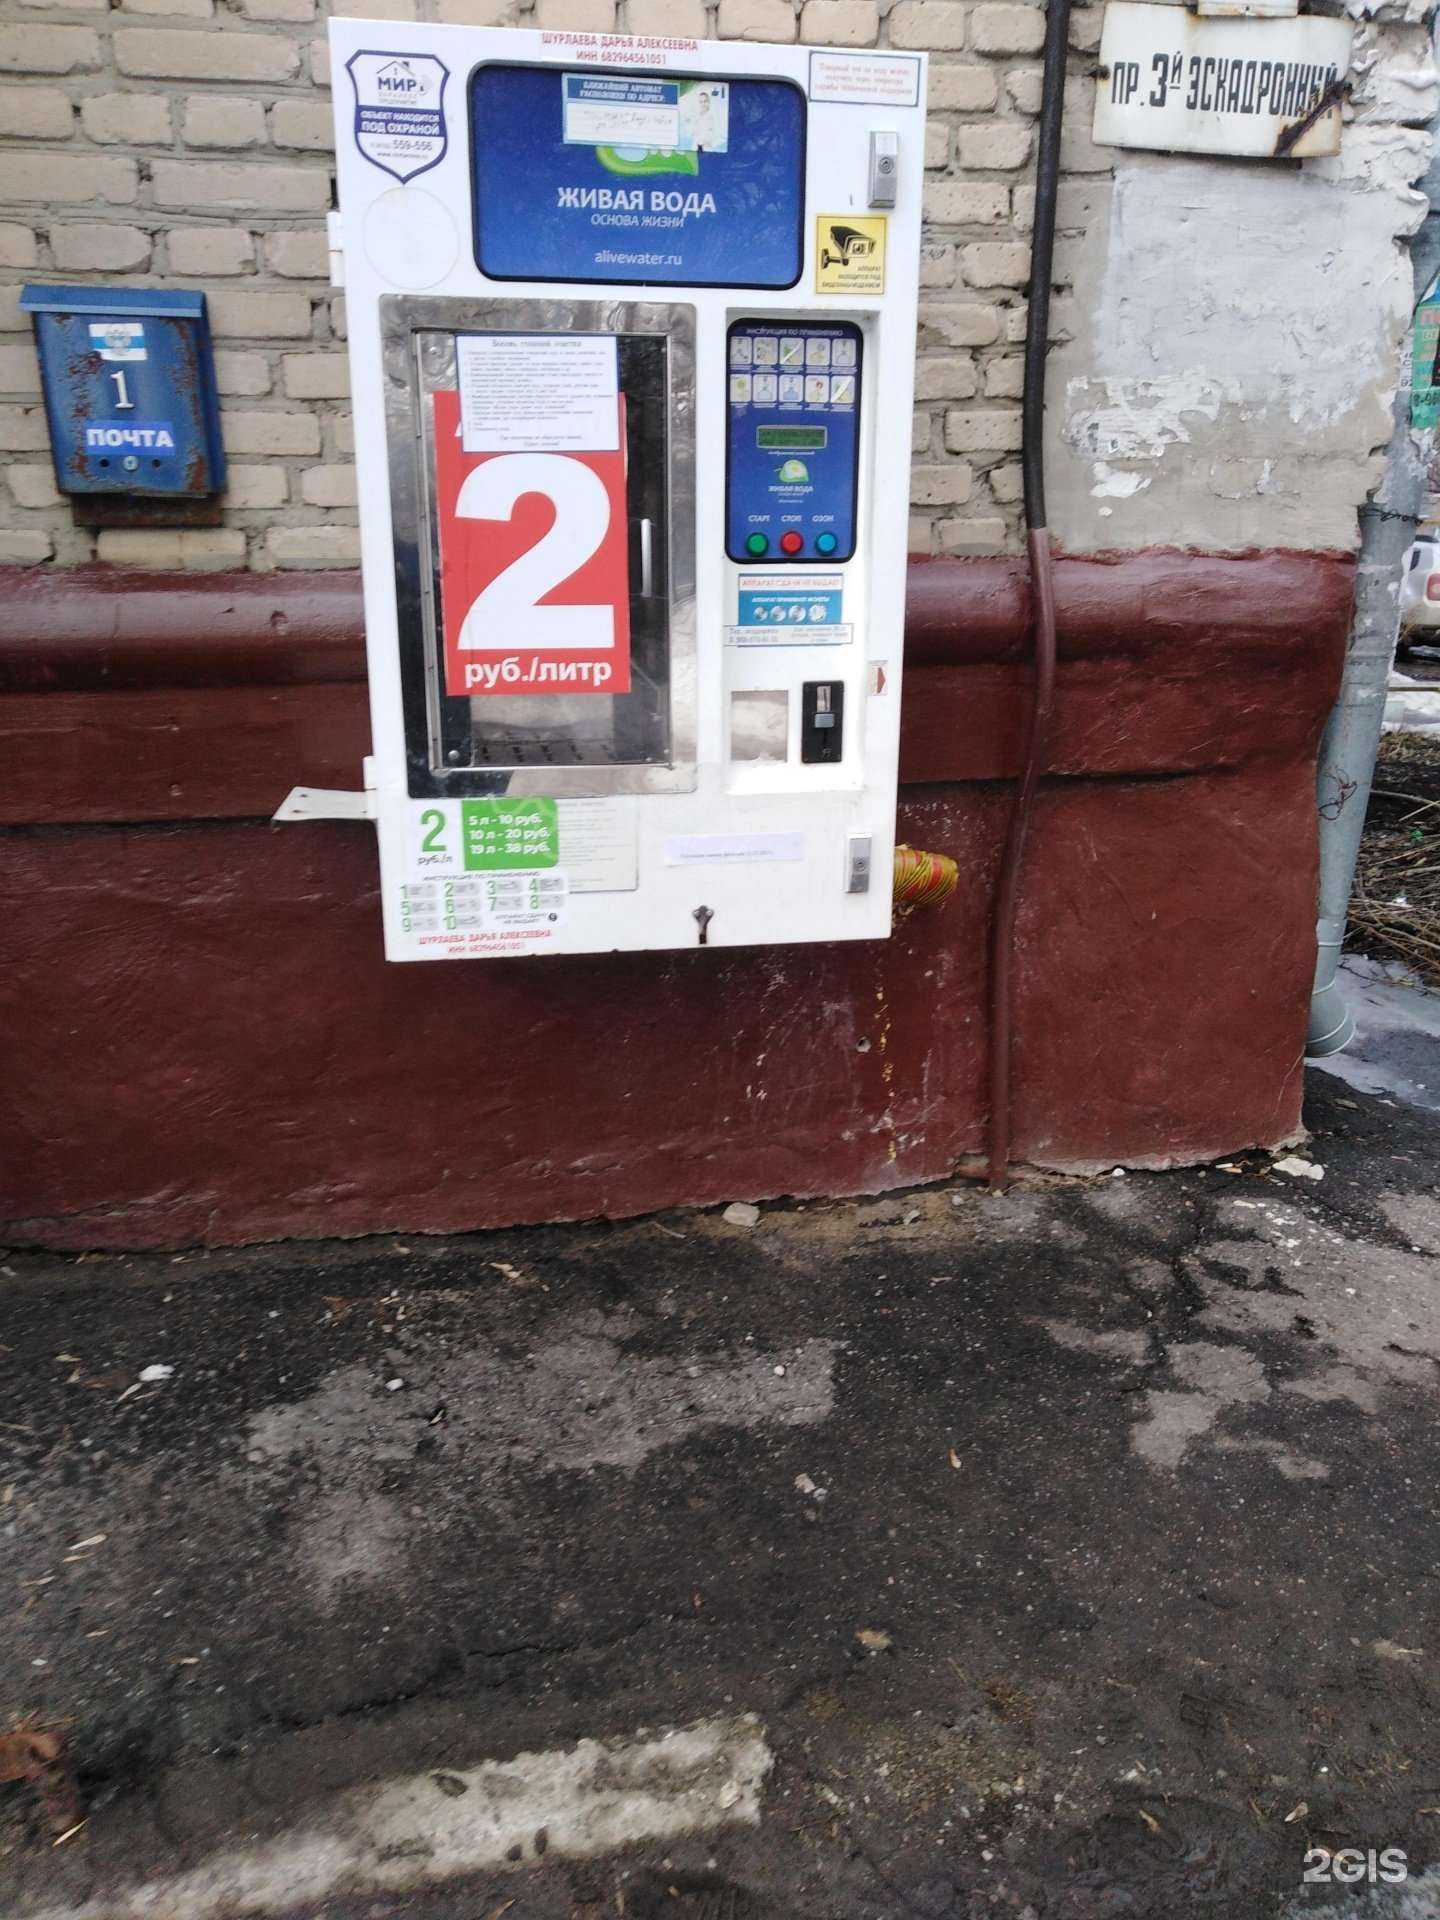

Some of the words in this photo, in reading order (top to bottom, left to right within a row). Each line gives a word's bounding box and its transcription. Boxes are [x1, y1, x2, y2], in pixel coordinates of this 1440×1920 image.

[542, 32, 597, 46] ШУРЛАЕВА
[600, 35, 635, 48] ДАРЬЯ
[637, 37, 698, 51] АЛЕКСЕЕВНА
[576, 50, 598, 61] ИНН
[378, 77, 417, 92] МИР
[1111, 61, 1145, 106] ПР.
[387, 123, 440, 136] ОХРАНОЙ
[557, 186, 644, 211] ЖИВАЯ
[651, 191, 717, 218] ВОДА
[591, 213, 640, 227] ОСНОВА
[641, 216, 685, 229] ЖИЗНИ
[594, 250, 683, 266] alivewater.ru
[110, 369, 135, 409] 1
[86, 428, 175, 448] ПОЧТА
[454, 452, 615, 650] 2
[464, 657, 613, 688] руб./литр
[420, 809, 447, 853] 2
[444, 882, 454, 898] 2
[487, 880, 496, 895] 3
[529, 879, 539, 894] 4
[488, 897, 497, 912] 7
